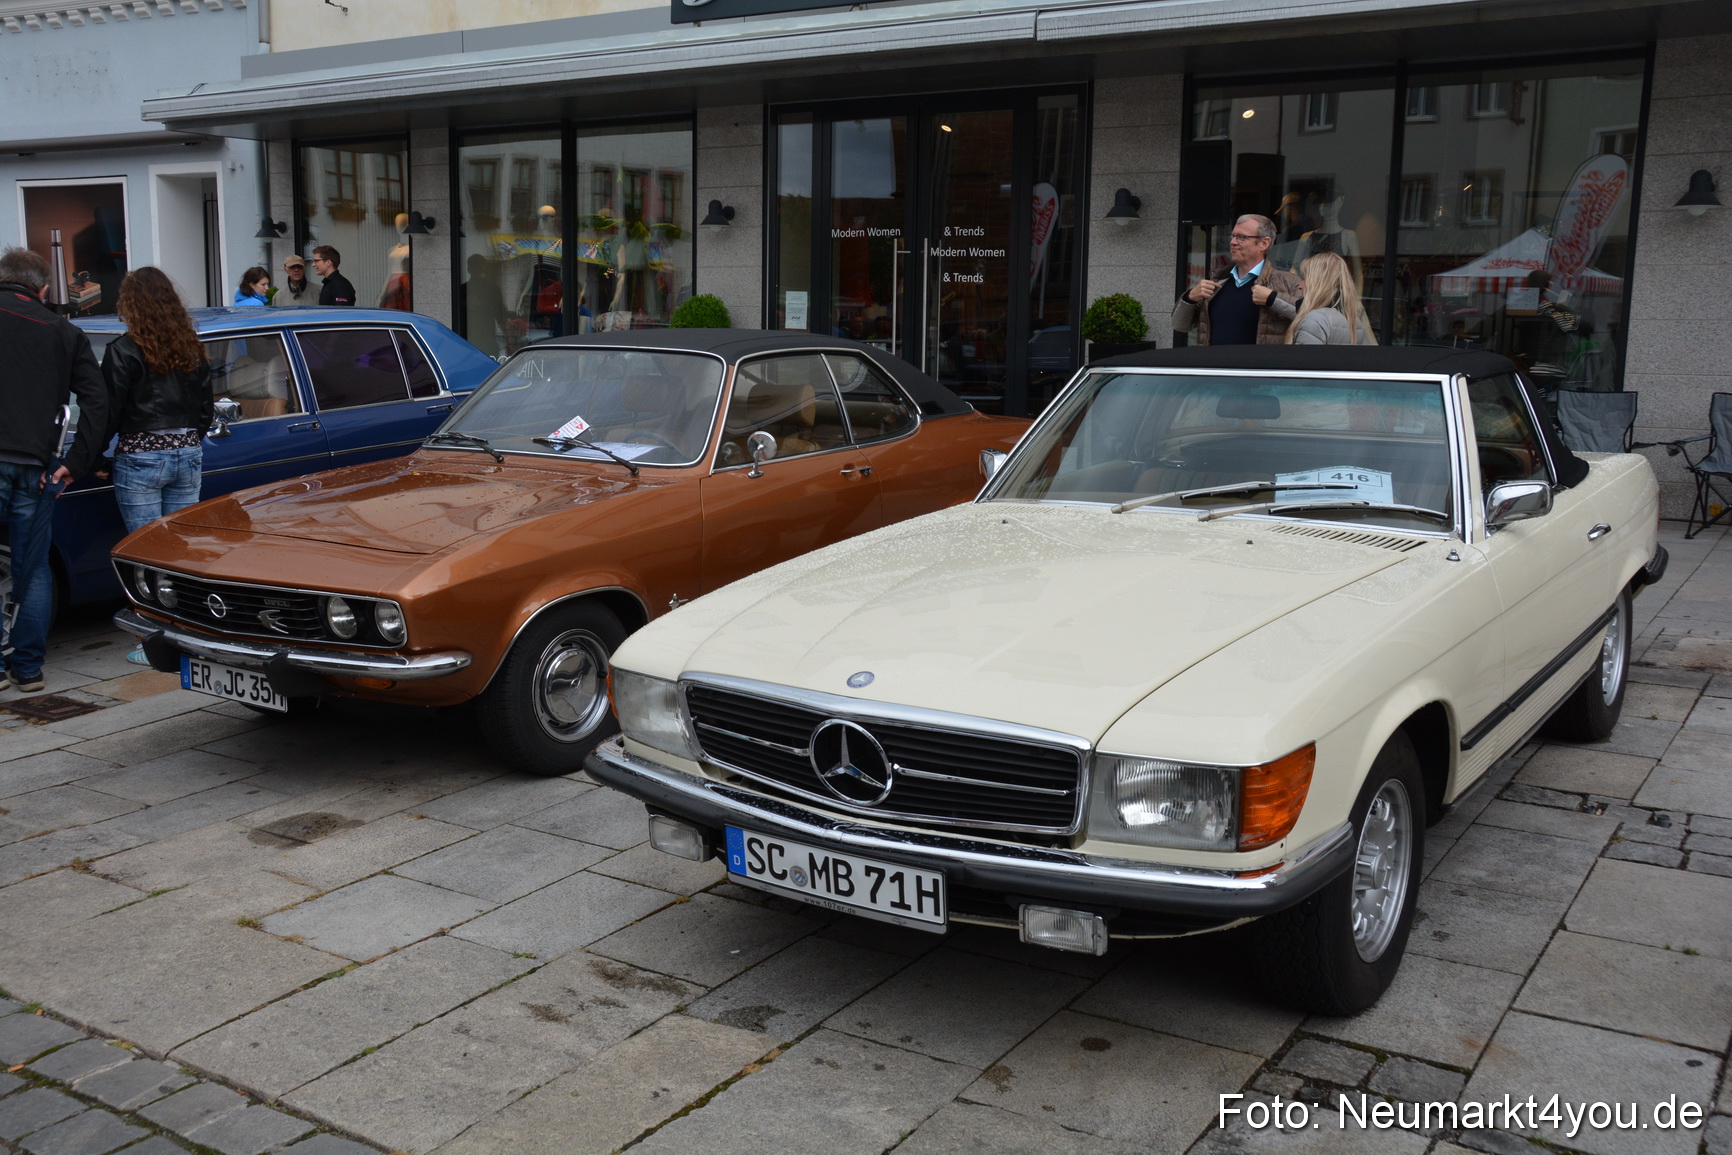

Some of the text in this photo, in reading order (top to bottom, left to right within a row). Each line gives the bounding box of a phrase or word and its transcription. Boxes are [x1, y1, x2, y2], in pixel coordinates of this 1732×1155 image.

[831, 225, 985, 238] Modern Women & Trends
[930, 247, 1006, 258] Modern Women
[943, 272, 984, 283] & Trends
[517, 359, 544, 378] AIN
[1330, 472, 1370, 483] 416
[190, 662, 212, 691] ER
[224, 669, 246, 698] JC
[733, 853, 741, 866] D
[747, 836, 941, 917] SC MB 71H
[803, 897, 857, 914] www.107er.de
